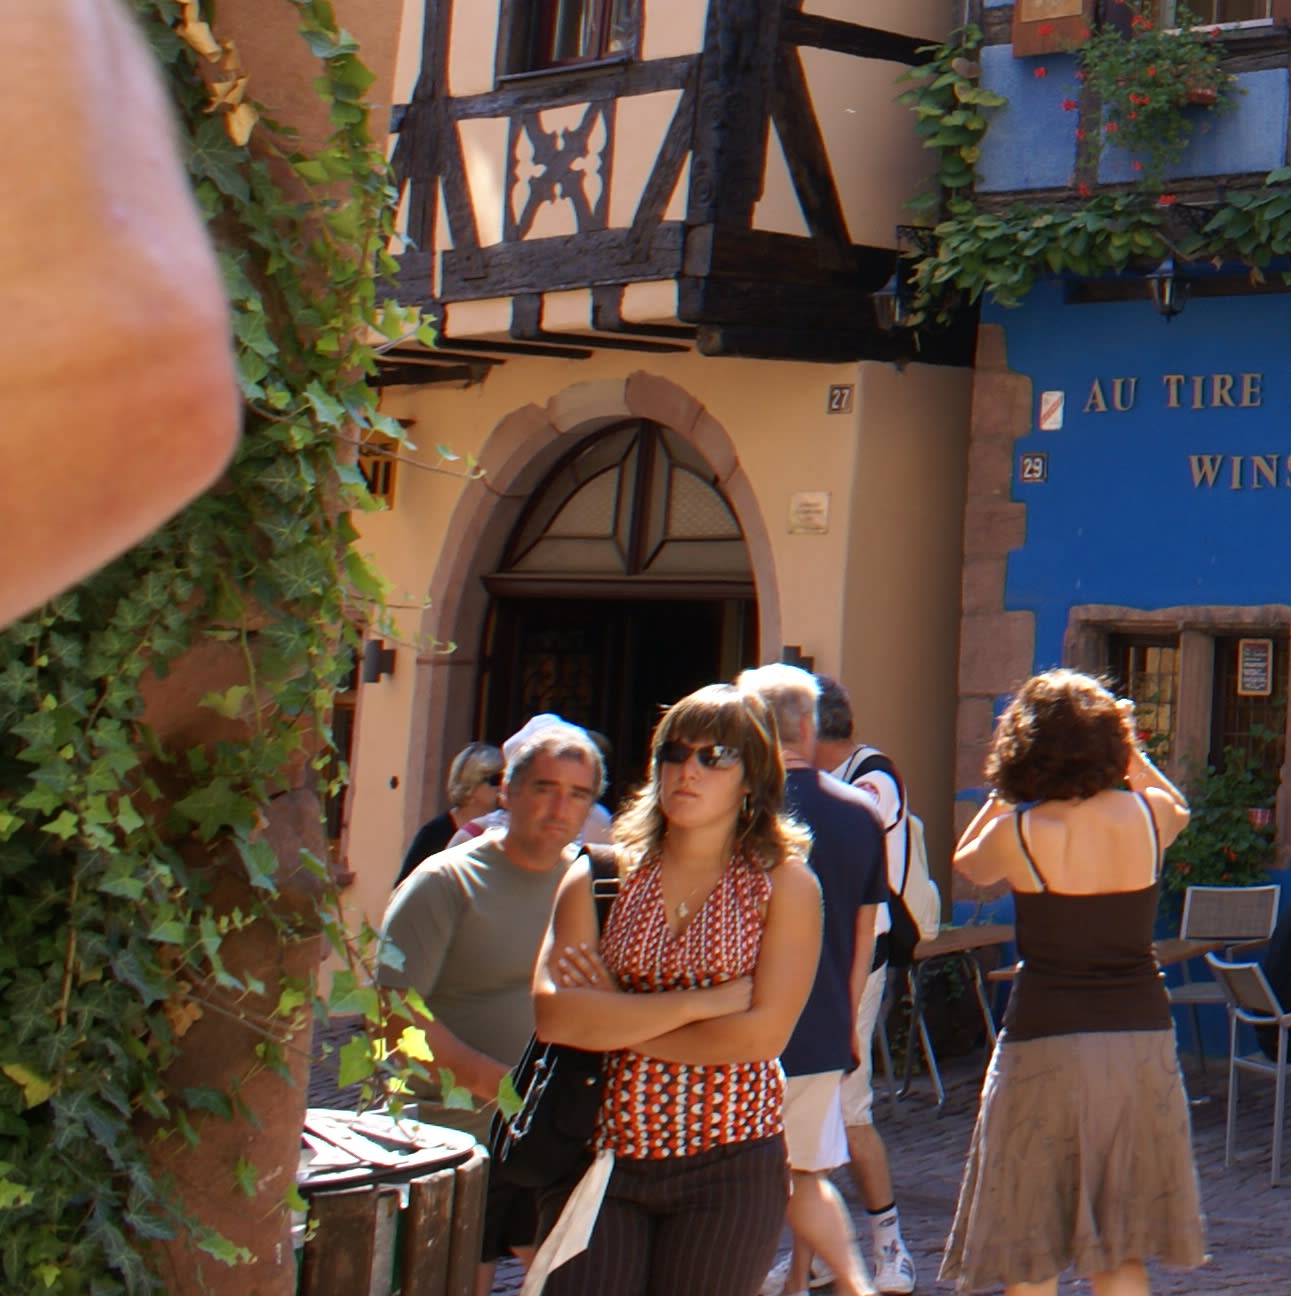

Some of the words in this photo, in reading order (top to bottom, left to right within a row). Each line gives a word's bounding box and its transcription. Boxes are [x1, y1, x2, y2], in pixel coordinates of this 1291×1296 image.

[831, 388, 851, 410] 27
[1082, 377, 1138, 413] AU
[1162, 373, 1263, 409] TIRE
[1022, 456, 1046, 480] 29
